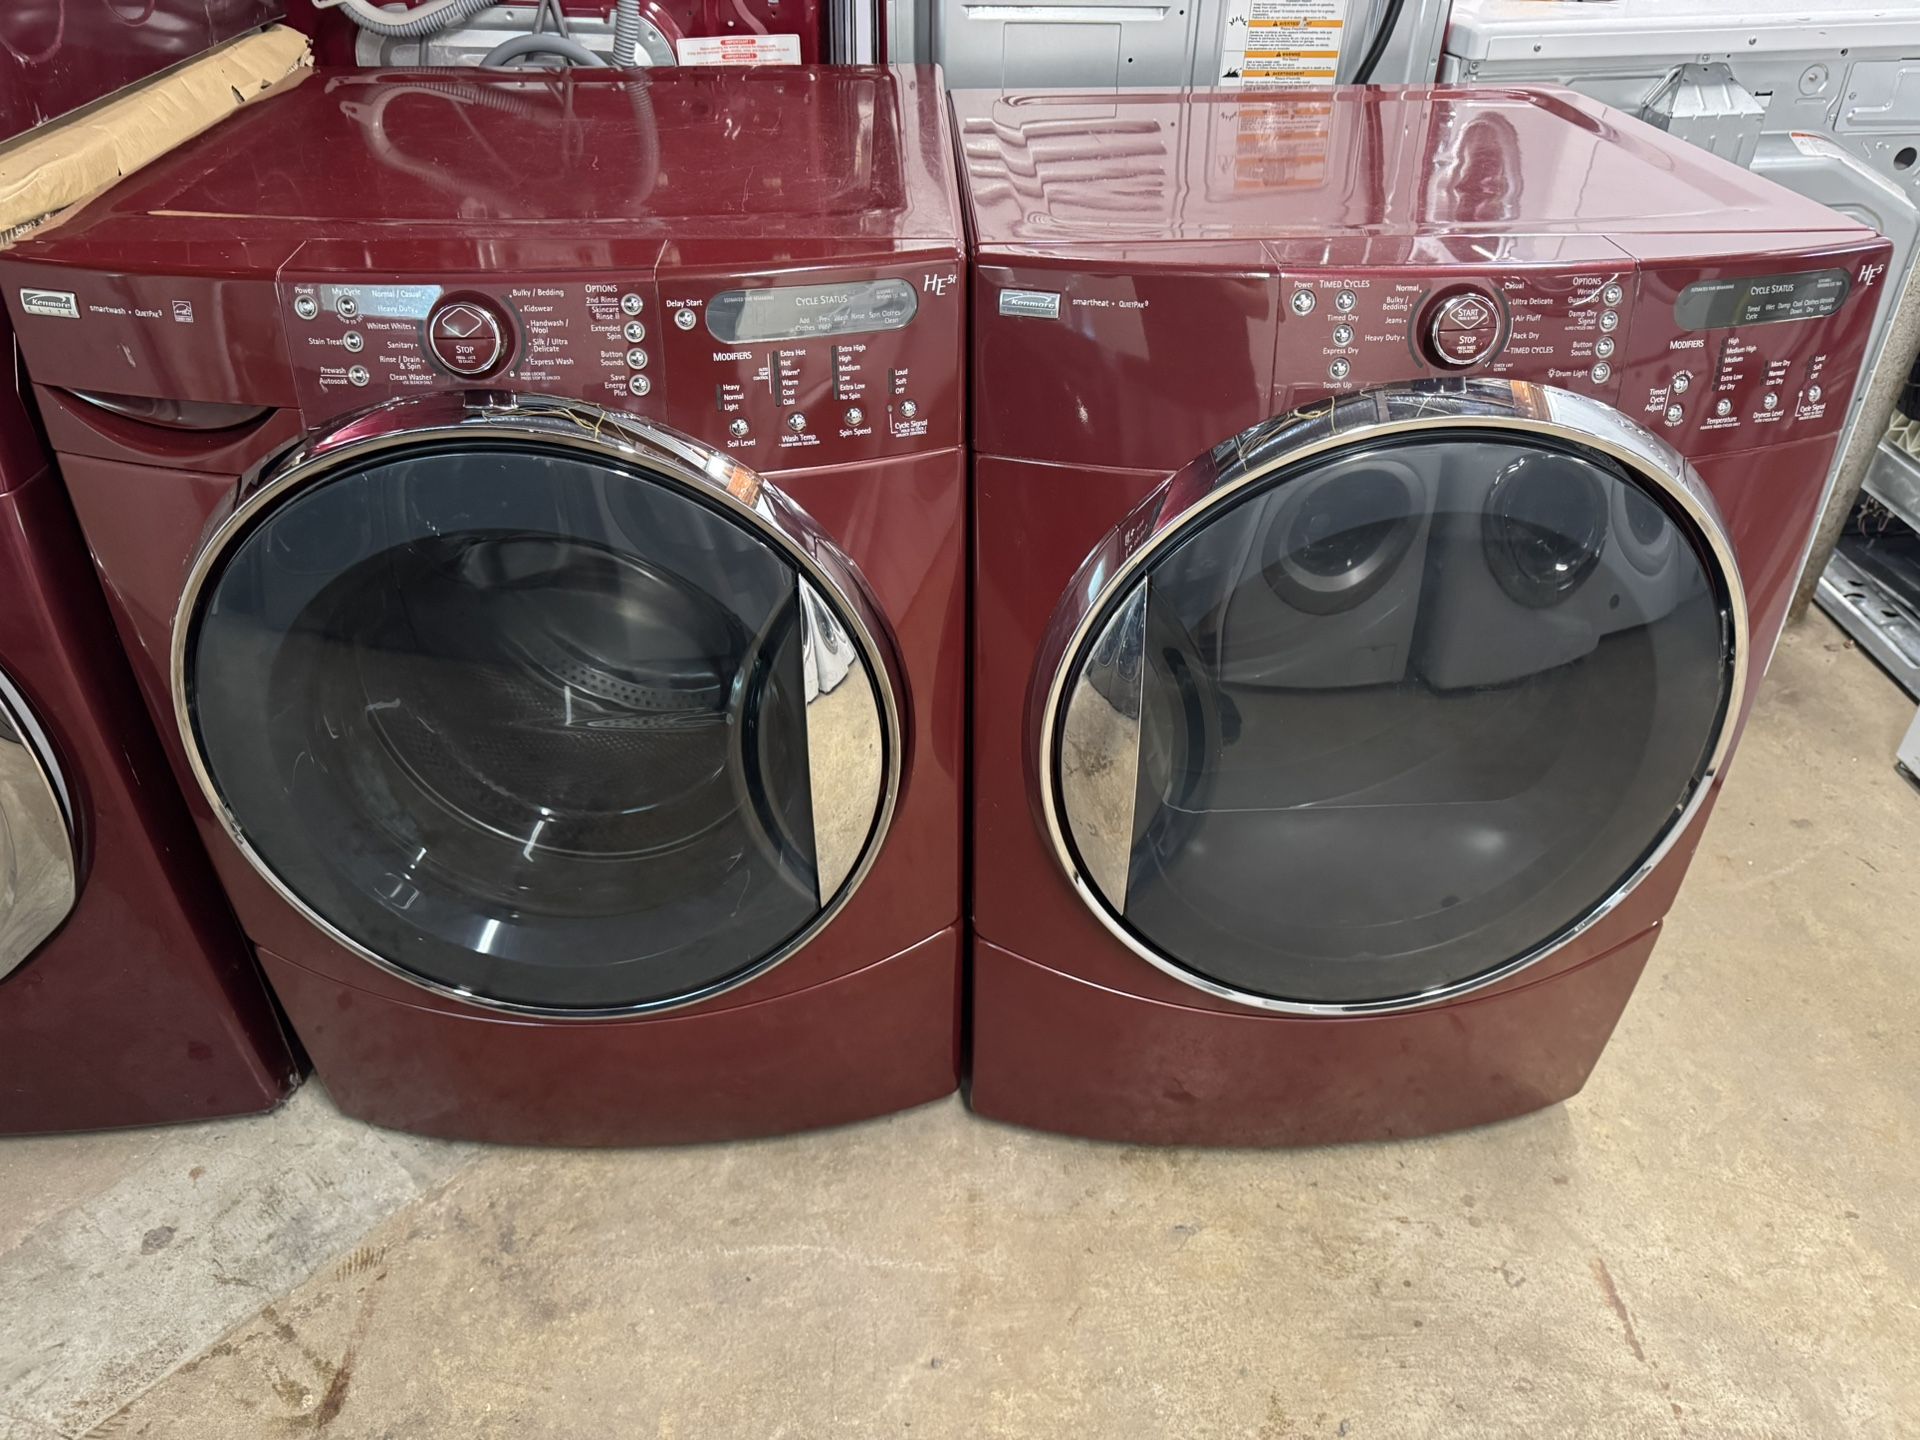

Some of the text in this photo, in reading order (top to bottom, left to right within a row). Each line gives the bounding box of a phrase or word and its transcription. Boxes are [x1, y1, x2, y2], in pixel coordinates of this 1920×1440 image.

[1294, 280, 1314, 288] Power
[1320, 280, 1370, 288] TIMED CYCLES
[1572, 276, 1602, 286] OPTIONS
[294, 287, 314, 295] Power
[332, 287, 361, 296] My Cycle
[585, 284, 618, 293] OPTIONS
[1396, 284, 1420, 292] Normal
[1751, 284, 1794, 296] CYCLE STATUS
[372, 290, 421, 298] Normal Casual
[512, 288, 564, 297] Bulky Bedding
[32, 298, 71, 308] Kenmore
[586, 296, 598, 304] 2nd
[666, 299, 702, 308] Delay Start
[796, 294, 848, 306] CYCLE STATUS
[1012, 299, 1056, 308] Kenmore
[1072, 298, 1110, 308] smartheat
[1386, 296, 1404, 304] Bulky
[89, 305, 126, 315] smartwash
[377, 305, 414, 314] Heavy Duty
[1382, 303, 1408, 311] Bedding
[1458, 308, 1479, 316] START
[1568, 310, 1598, 318] Damp Dry
[1327, 314, 1359, 322] Timed Dry
[1526, 314, 1542, 322] Fluff
[1578, 318, 1596, 326] Signal
[366, 322, 412, 330] Whitest Whites
[530, 319, 564, 327] Handwash
[608, 333, 622, 341] Spin
[1386, 334, 1400, 342] Duty
[1459, 336, 1477, 344] STOP
[1513, 332, 1540, 340] Rack Dry
[308, 338, 344, 346] Stain Treat
[387, 341, 414, 350] Sanitary
[532, 338, 568, 346] Silk Ultra
[1669, 339, 1704, 350] MODIFIERS
[1728, 338, 1740, 346] High
[456, 345, 474, 354] STOP
[853, 344, 866, 352] High
[1323, 348, 1359, 356] Express Dry
[1510, 346, 1554, 354] TIMED CYCLES
[1746, 345, 1757, 354] High
[379, 356, 420, 364] Rinse Drain
[713, 351, 752, 362] MODIFIERS
[1724, 356, 1744, 364] Medium
[530, 358, 554, 366] Express
[320, 366, 346, 374] Prewash
[407, 362, 422, 372] Spin
[839, 364, 861, 372] Medium
[895, 368, 908, 376] Loud
[1573, 370, 1588, 378] Light
[390, 373, 432, 381] Clean Washer
[610, 374, 626, 382] Save
[604, 382, 626, 390] Energy
[723, 384, 740, 392] Heavy
[1342, 382, 1352, 390] Up
[849, 392, 861, 400] Spin
[1650, 388, 1668, 396] Timed
[783, 398, 796, 406] Cold
[1650, 396, 1666, 404] Cycle
[724, 404, 739, 412] Light
[1644, 404, 1664, 412] Adjust
[895, 418, 928, 430] Cycle Signal
[1706, 416, 1738, 426] Temperature
[840, 427, 872, 438] Spin Speed
[782, 434, 816, 442] Wash Temp
[728, 438, 756, 448] Soil Level
